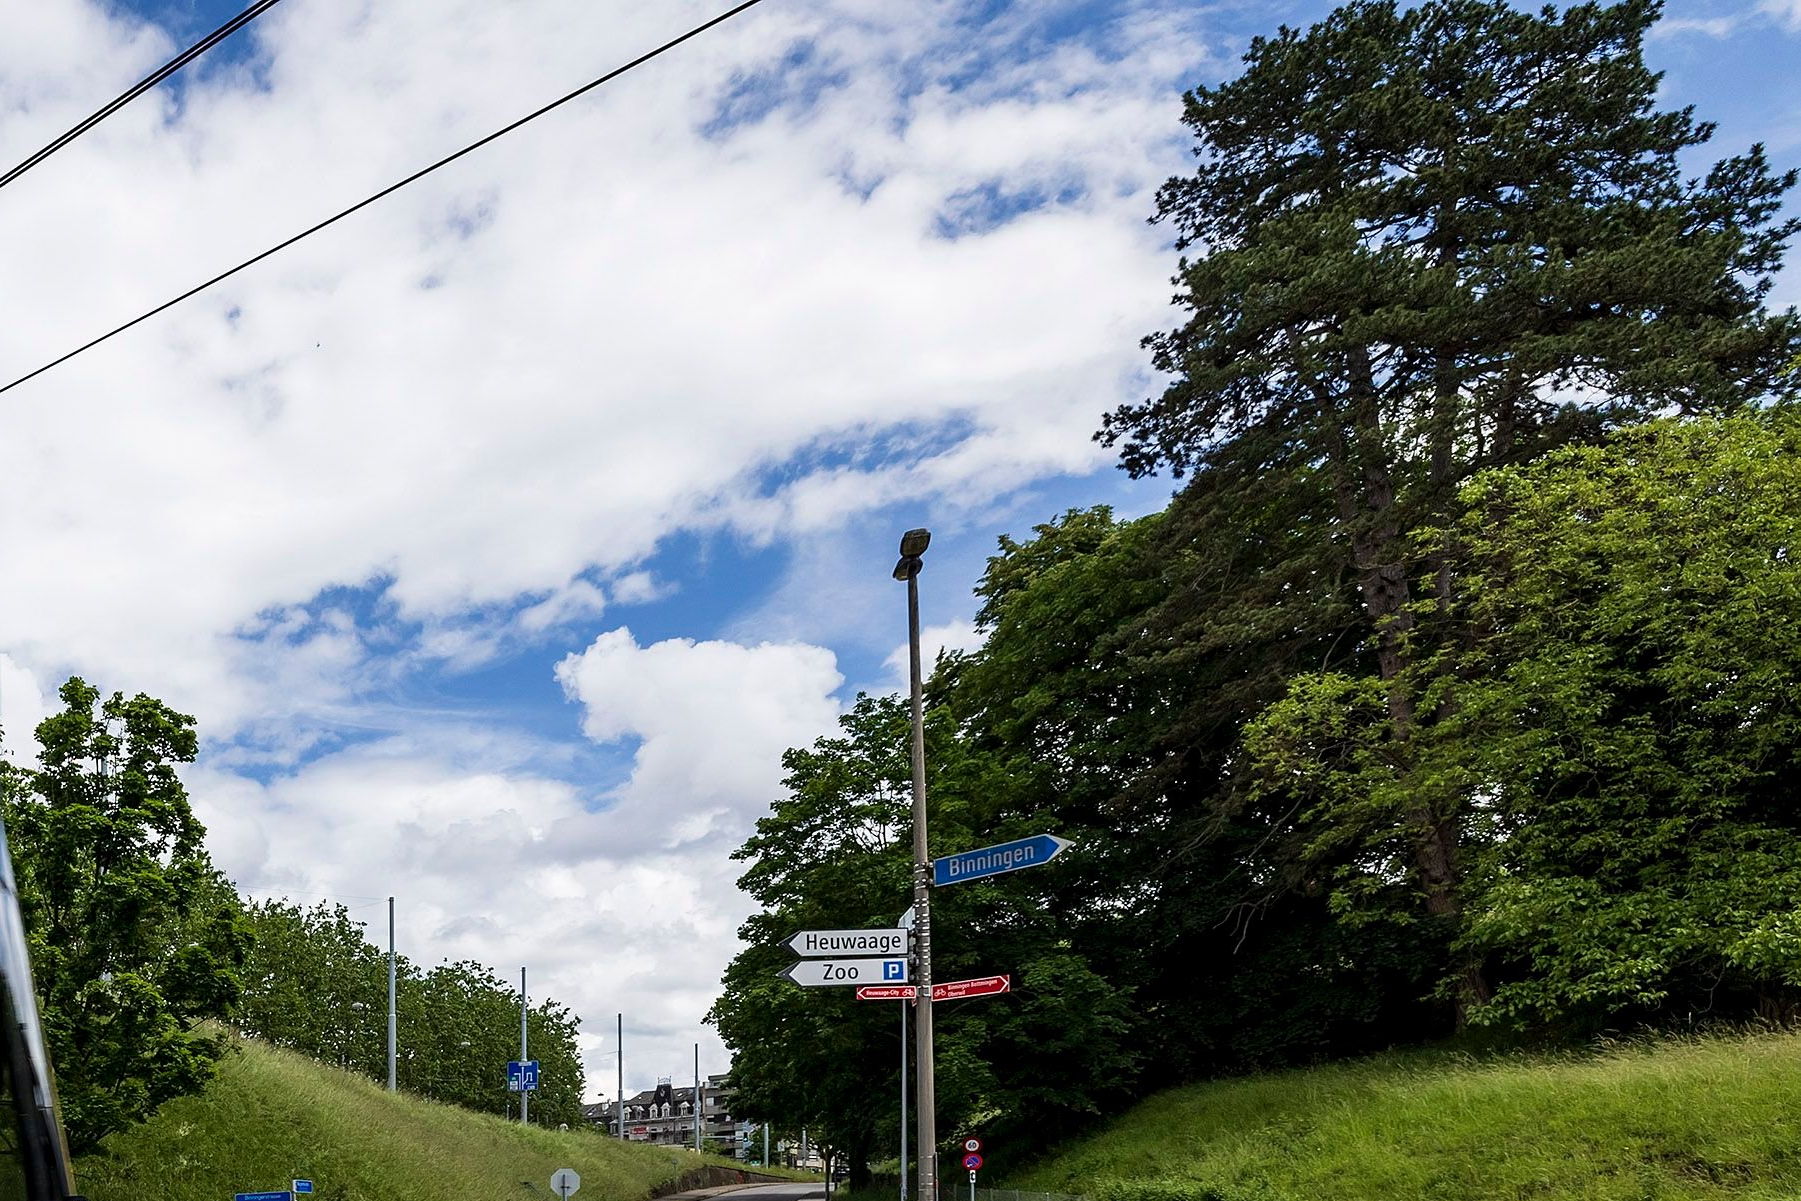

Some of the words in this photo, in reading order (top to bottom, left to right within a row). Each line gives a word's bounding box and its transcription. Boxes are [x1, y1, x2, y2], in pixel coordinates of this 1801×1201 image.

[949, 845, 1034, 877] Binningen
[806, 933, 902, 953] Heuwaage
[822, 963, 859, 980] Zoo
[888, 963, 899, 979] P
